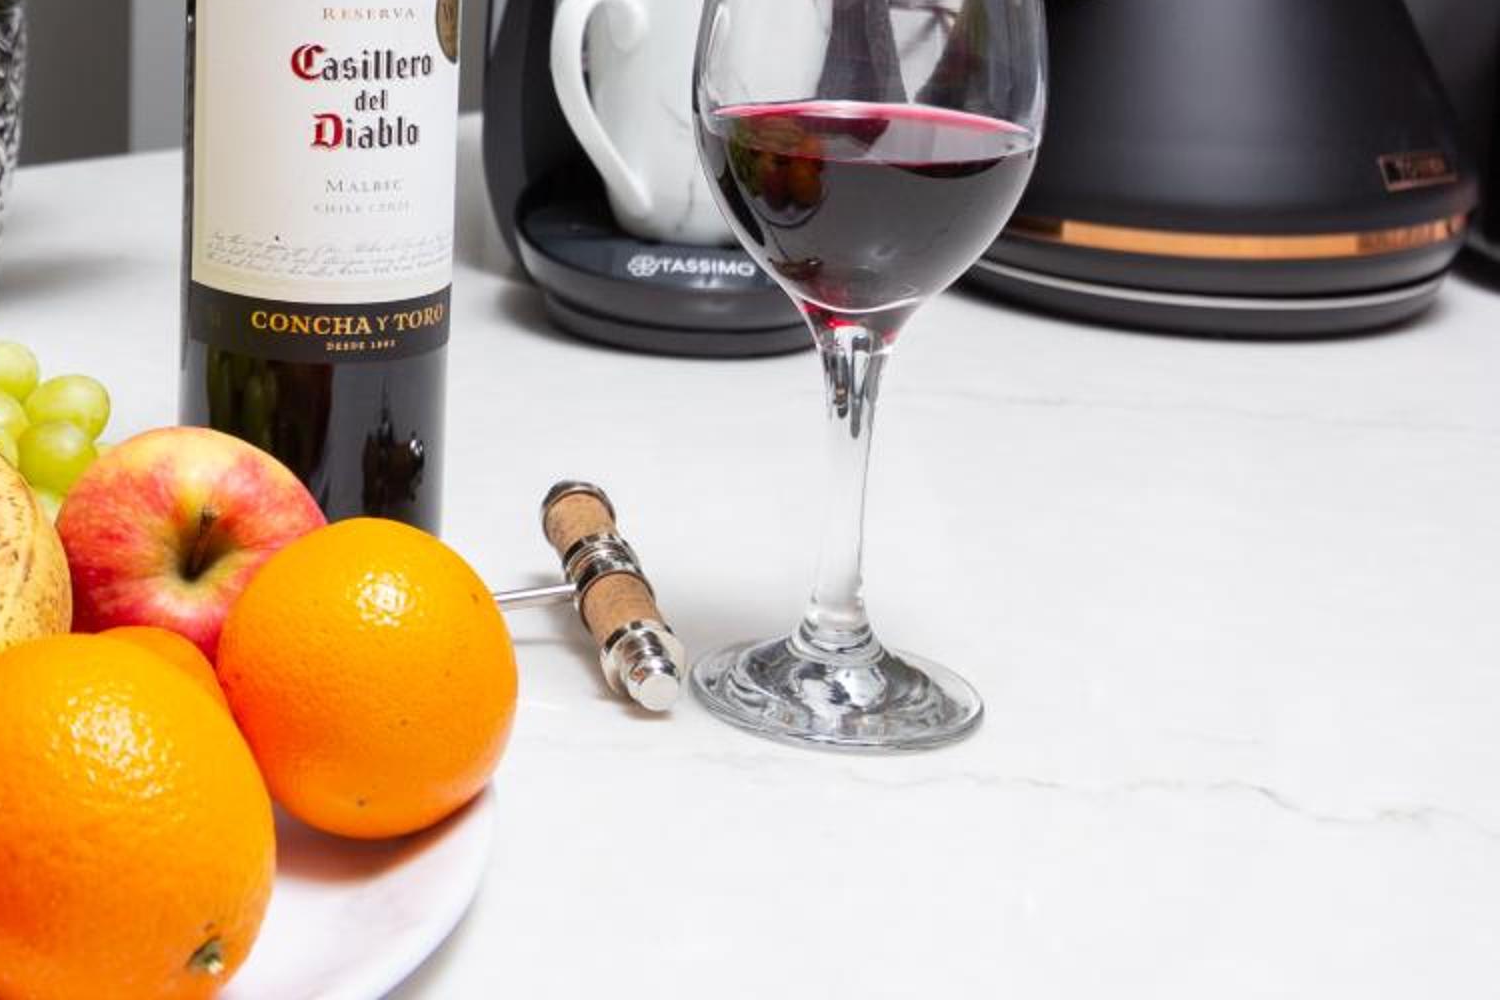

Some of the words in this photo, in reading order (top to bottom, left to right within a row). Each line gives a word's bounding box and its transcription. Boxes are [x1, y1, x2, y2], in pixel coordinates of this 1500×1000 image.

[323, 7, 416, 20] RESERVA
[291, 43, 433, 81] Casillero
[355, 89, 387, 111] del
[311, 112, 420, 149] Diablo
[660, 256, 756, 277] TASSIMO
[250, 310, 372, 335] CONCHA
[375, 316, 390, 332] Y
[393, 303, 444, 331] TORO
